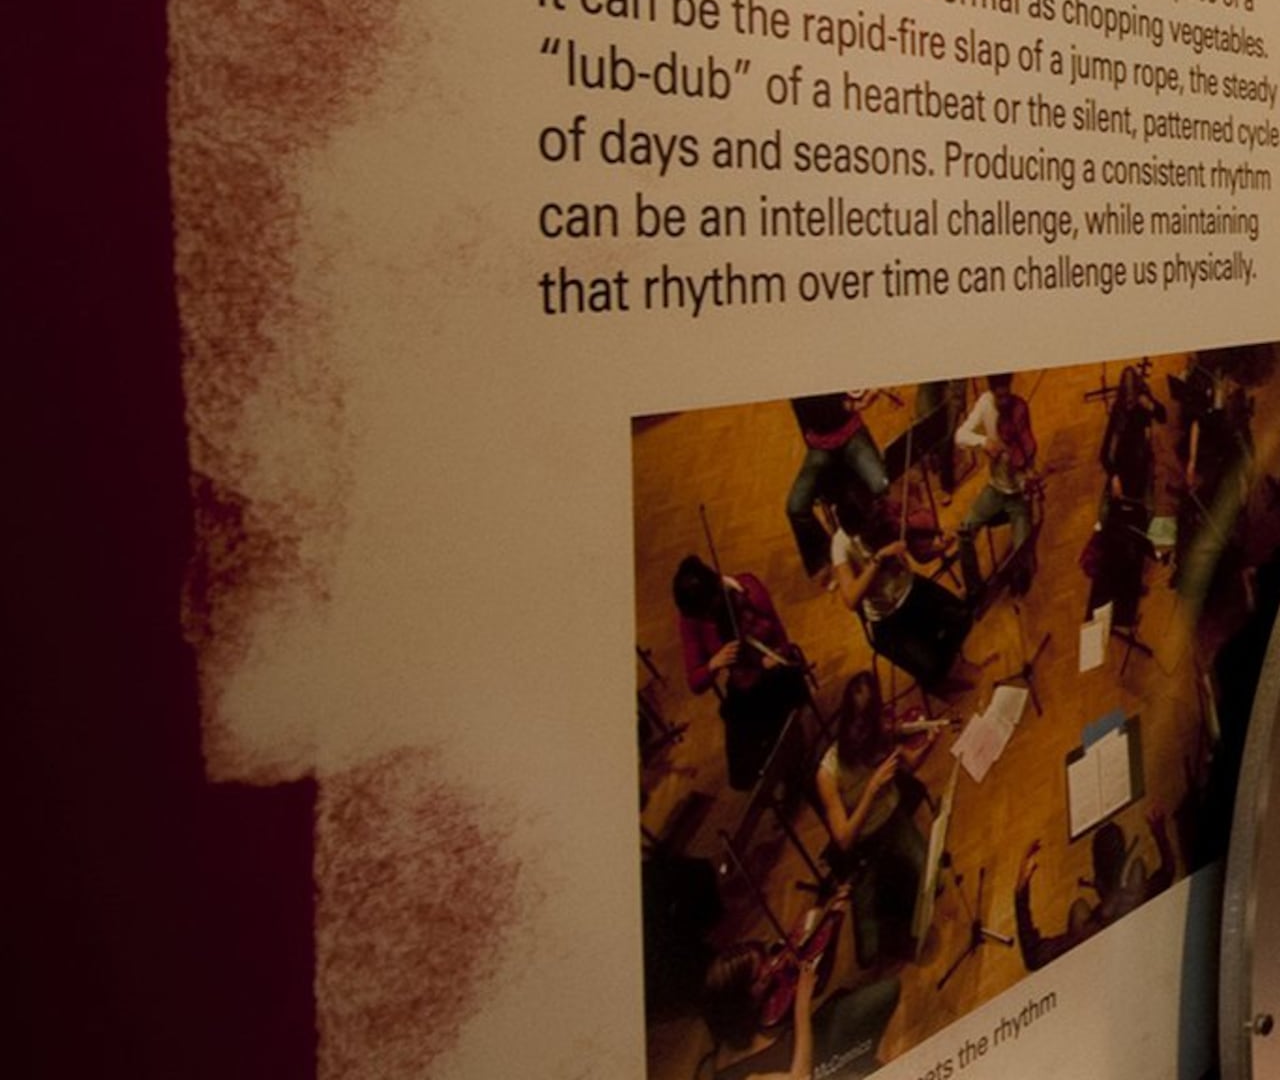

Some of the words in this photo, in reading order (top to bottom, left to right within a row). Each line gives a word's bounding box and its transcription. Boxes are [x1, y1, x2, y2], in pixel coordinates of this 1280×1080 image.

[803, 10, 946, 60] rapid-fire
[954, 28, 1010, 76] slap
[1070, 44, 1127, 90] jump
[1134, 63, 1184, 95] rope,
[1189, 64, 1218, 96] the
[1222, 75, 1278, 109] steady
[1169, 20, 1268, 58] vegetables.
[540, 37, 751, 100] “lub-dub”
[766, 65, 803, 106] of
[844, 71, 986, 123] heartbeat
[1027, 93, 1066, 129] the
[1073, 98, 1137, 138] silent,
[1143, 112, 1234, 144] patterned
[1237, 120, 1280, 151] cycle
[539, 114, 587, 162] of
[600, 118, 699, 177] days
[712, 129, 781, 171] and
[794, 141, 934, 177] seasons.
[945, 140, 1075, 191] Producing
[1102, 155, 1206, 188] consistent
[1211, 160, 1271, 195] rhythm
[539, 202, 619, 238] can
[636, 191, 686, 237] be
[700, 205, 746, 237] an
[760, 194, 938, 237] intellectual
[947, 199, 1079, 244] challenge,
[1084, 203, 1145, 235] while
[1151, 204, 1259, 241] maintaining
[538, 266, 630, 315] that
[645, 262, 785, 318] rhythm
[798, 270, 875, 302] over
[882, 259, 950, 298] time
[958, 266, 1005, 294] can
[1014, 255, 1127, 295] challenge
[1163, 252, 1257, 290] physically.
[957, 1035, 989, 1070] the
[992, 990, 1058, 1047] rhythm
